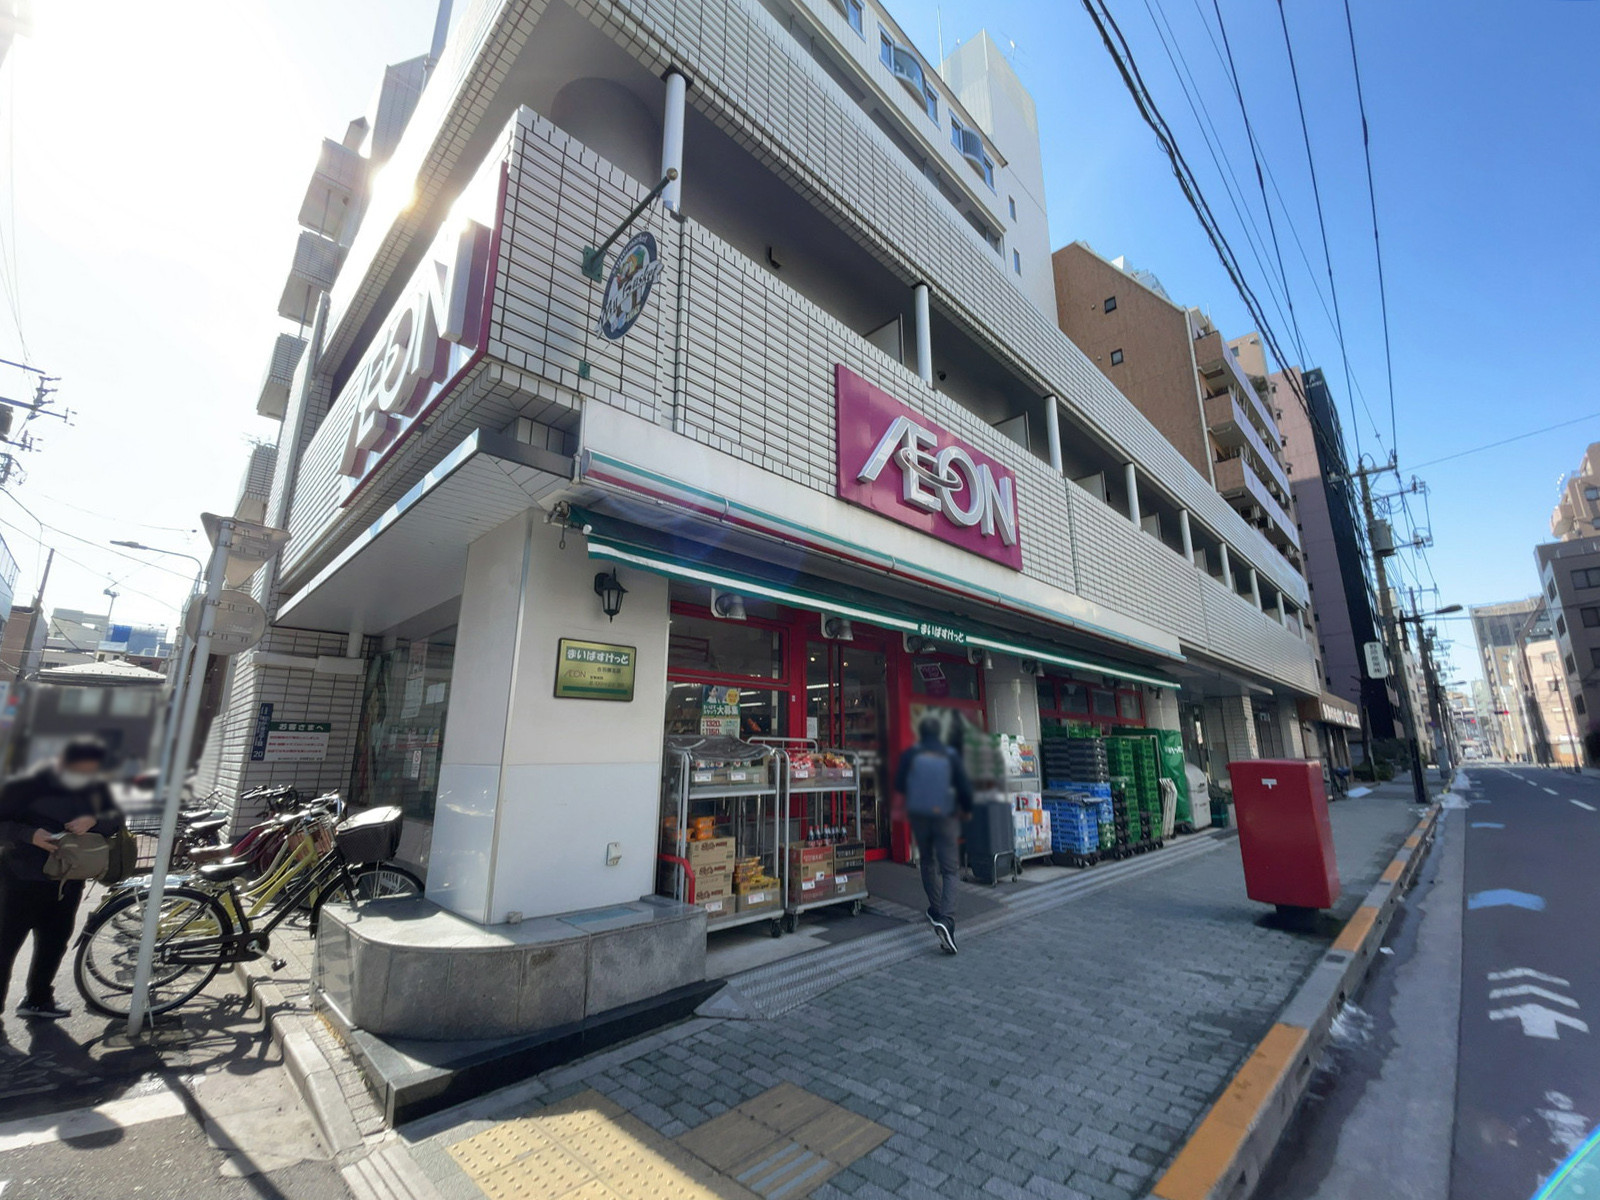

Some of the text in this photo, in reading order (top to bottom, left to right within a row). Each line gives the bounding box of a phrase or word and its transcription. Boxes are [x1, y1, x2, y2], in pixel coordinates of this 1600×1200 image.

[920, 623, 964, 643] まいばすけっと
[567, 649, 629, 665] まいばすけっと
[278, 723, 324, 731] お客さまへ
[253, 750, 263, 758] 20
